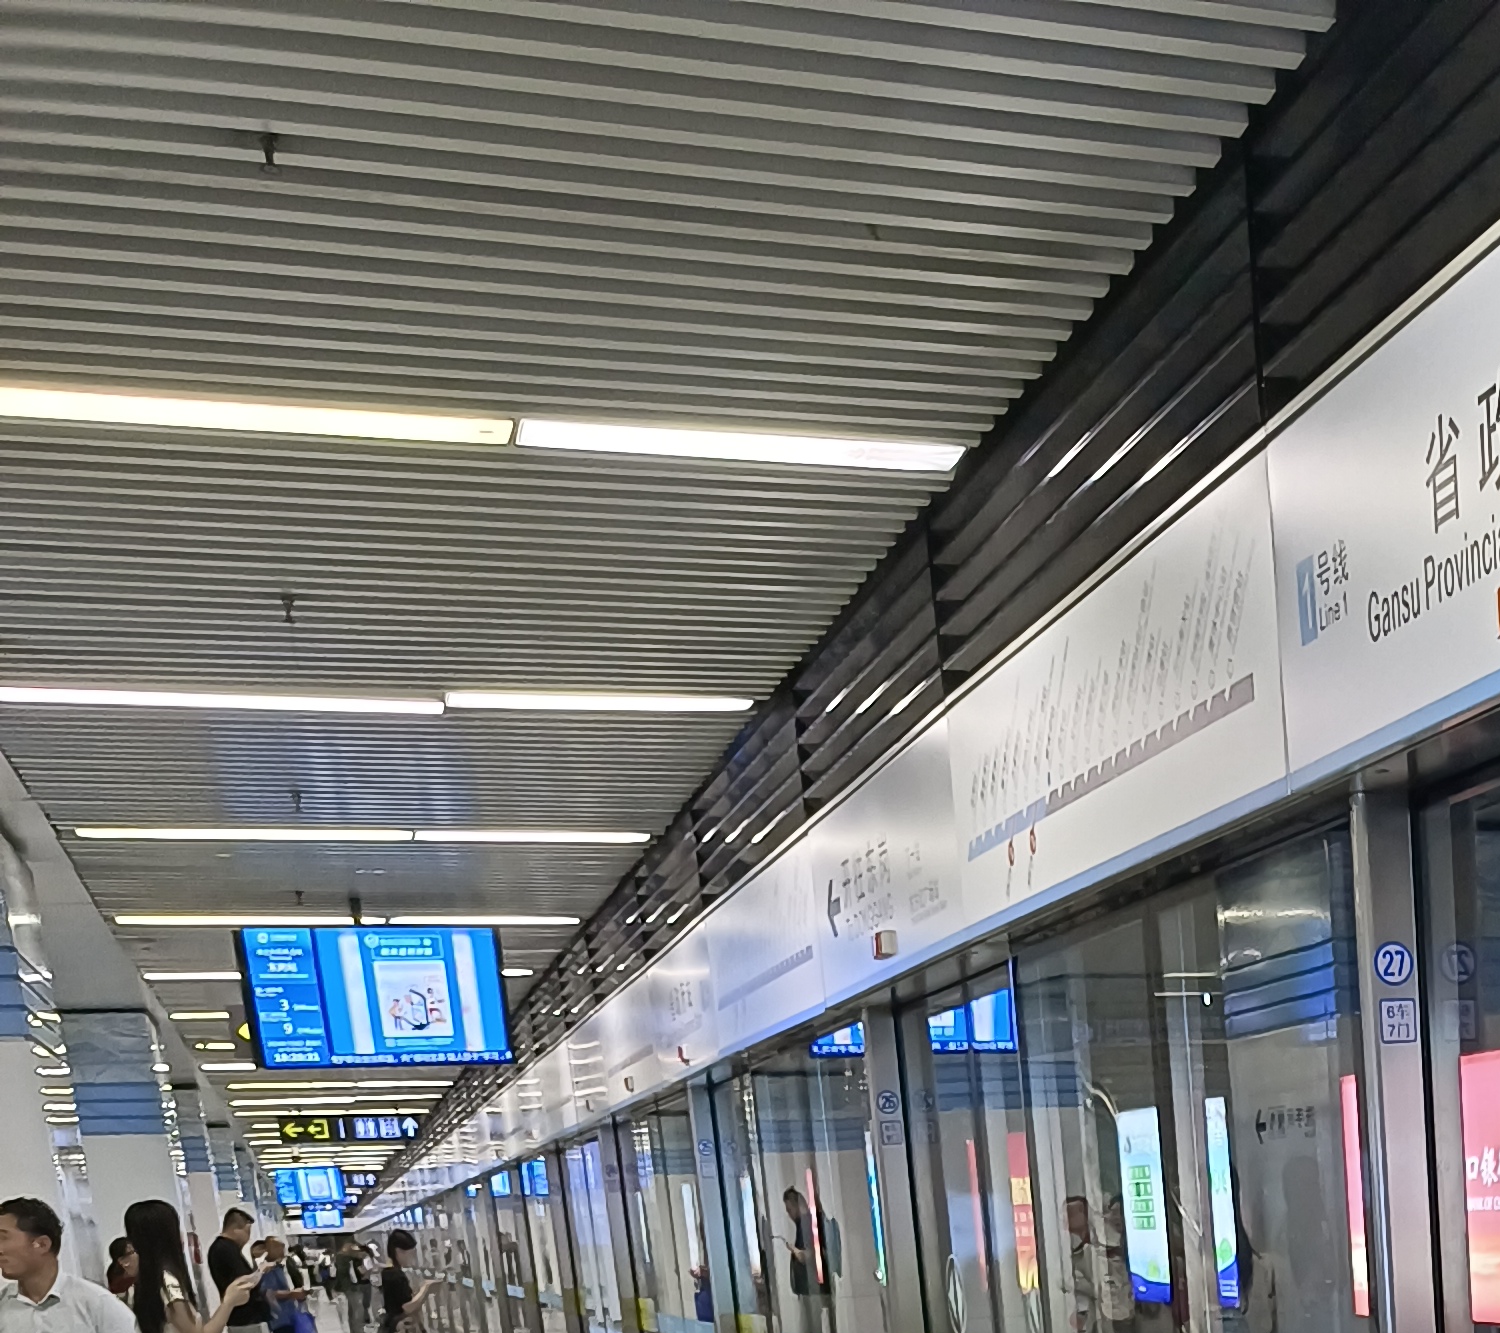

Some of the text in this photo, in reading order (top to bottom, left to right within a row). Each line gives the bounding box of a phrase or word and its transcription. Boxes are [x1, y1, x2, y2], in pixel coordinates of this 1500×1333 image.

[1316, 539, 1349, 597] 号线
[1318, 603, 1342, 634] Line
[1367, 574, 1421, 643] Gansu
[1382, 949, 1405, 977] 27
